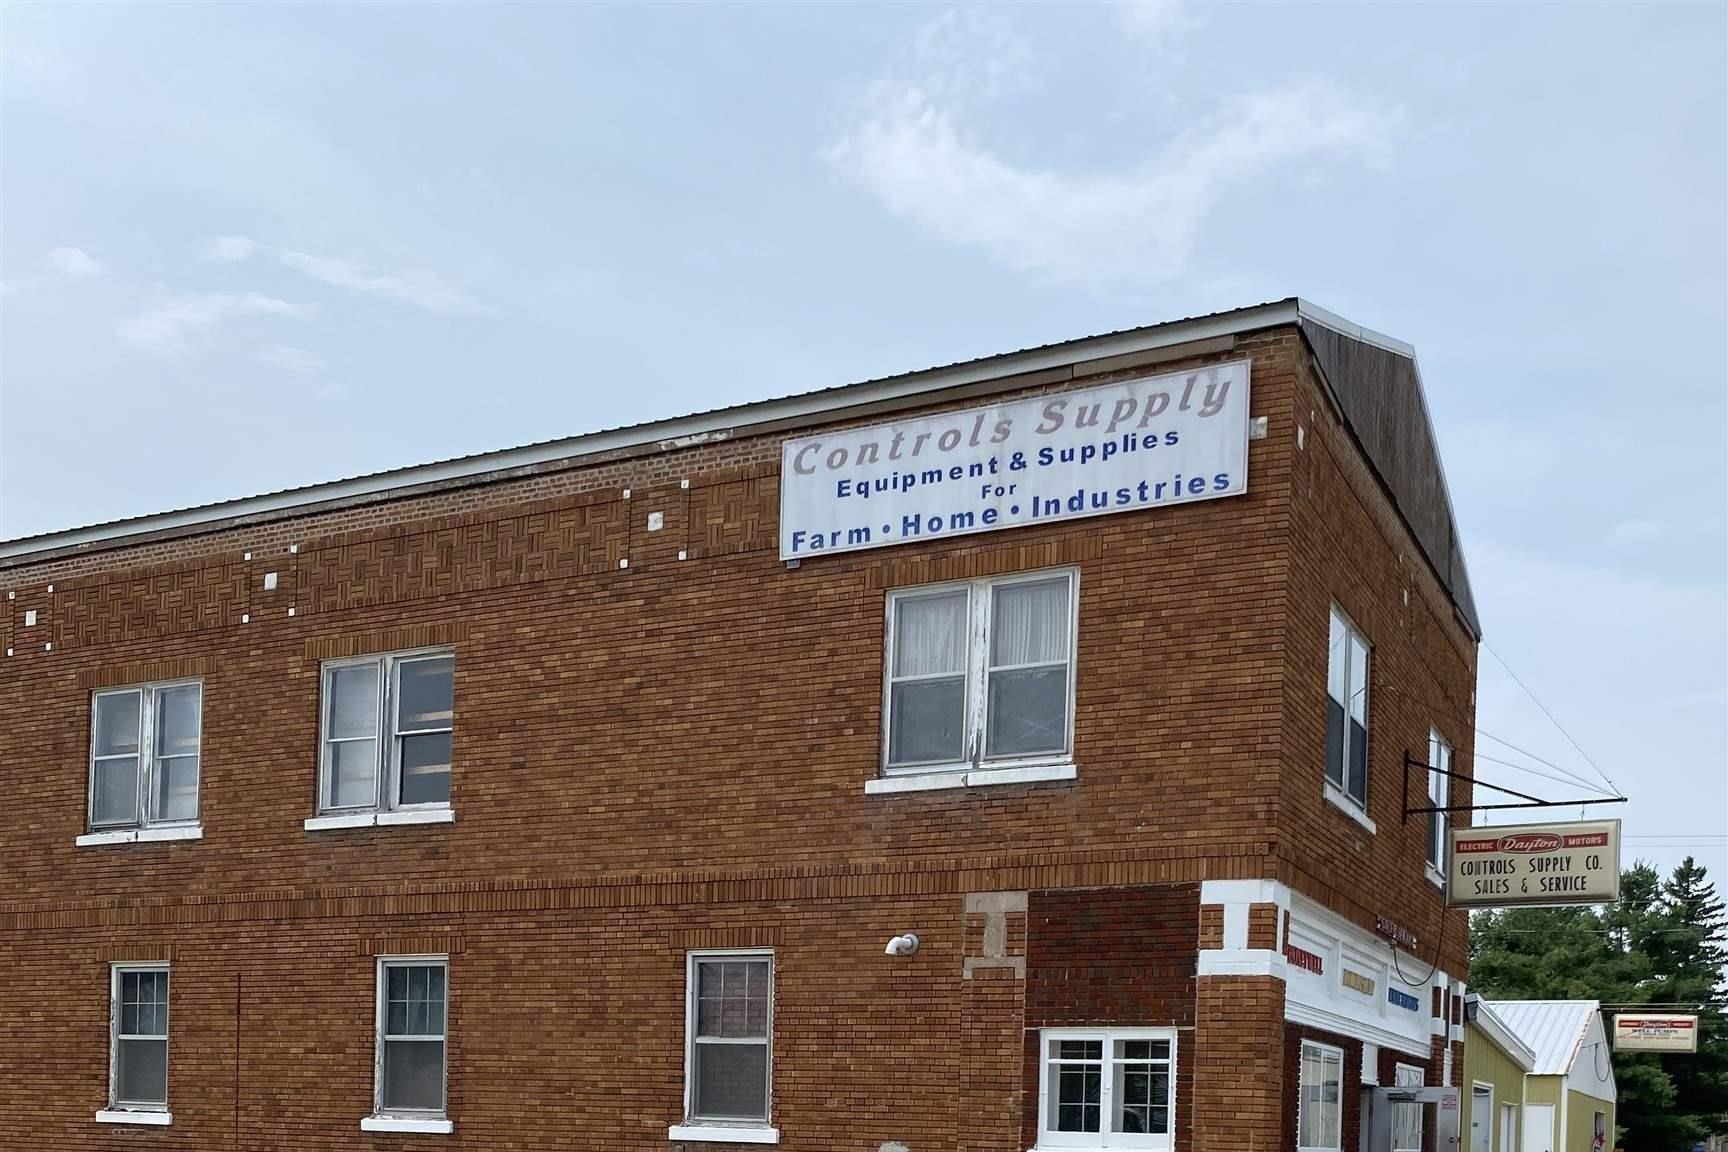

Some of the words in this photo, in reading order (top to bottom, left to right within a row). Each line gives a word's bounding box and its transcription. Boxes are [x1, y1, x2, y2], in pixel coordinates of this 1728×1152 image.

[793, 415, 1013, 476] Controls
[1035, 377, 1232, 433] Supply
[837, 456, 998, 498] Equipment
[1009, 451, 1027, 471] &
[1038, 430, 1180, 466] Supplies
[981, 482, 1017, 499] For
[792, 527, 871, 552] Farm
[902, 505, 998, 536] Home
[1032, 472, 1231, 518] Industries
[1460, 842, 1493, 850] ELECTRIC
[1503, 837, 1558, 853] Dayton
[1568, 836, 1601, 845] MOTORS
[1461, 858, 1515, 876] CONTROLS
[1529, 855, 1571, 873] SUPPLY
[1585, 854, 1602, 870] CO.
[1474, 879, 1509, 894] SALES
[1521, 878, 1528, 893] &
[1540, 876, 1587, 892] SERVICE
